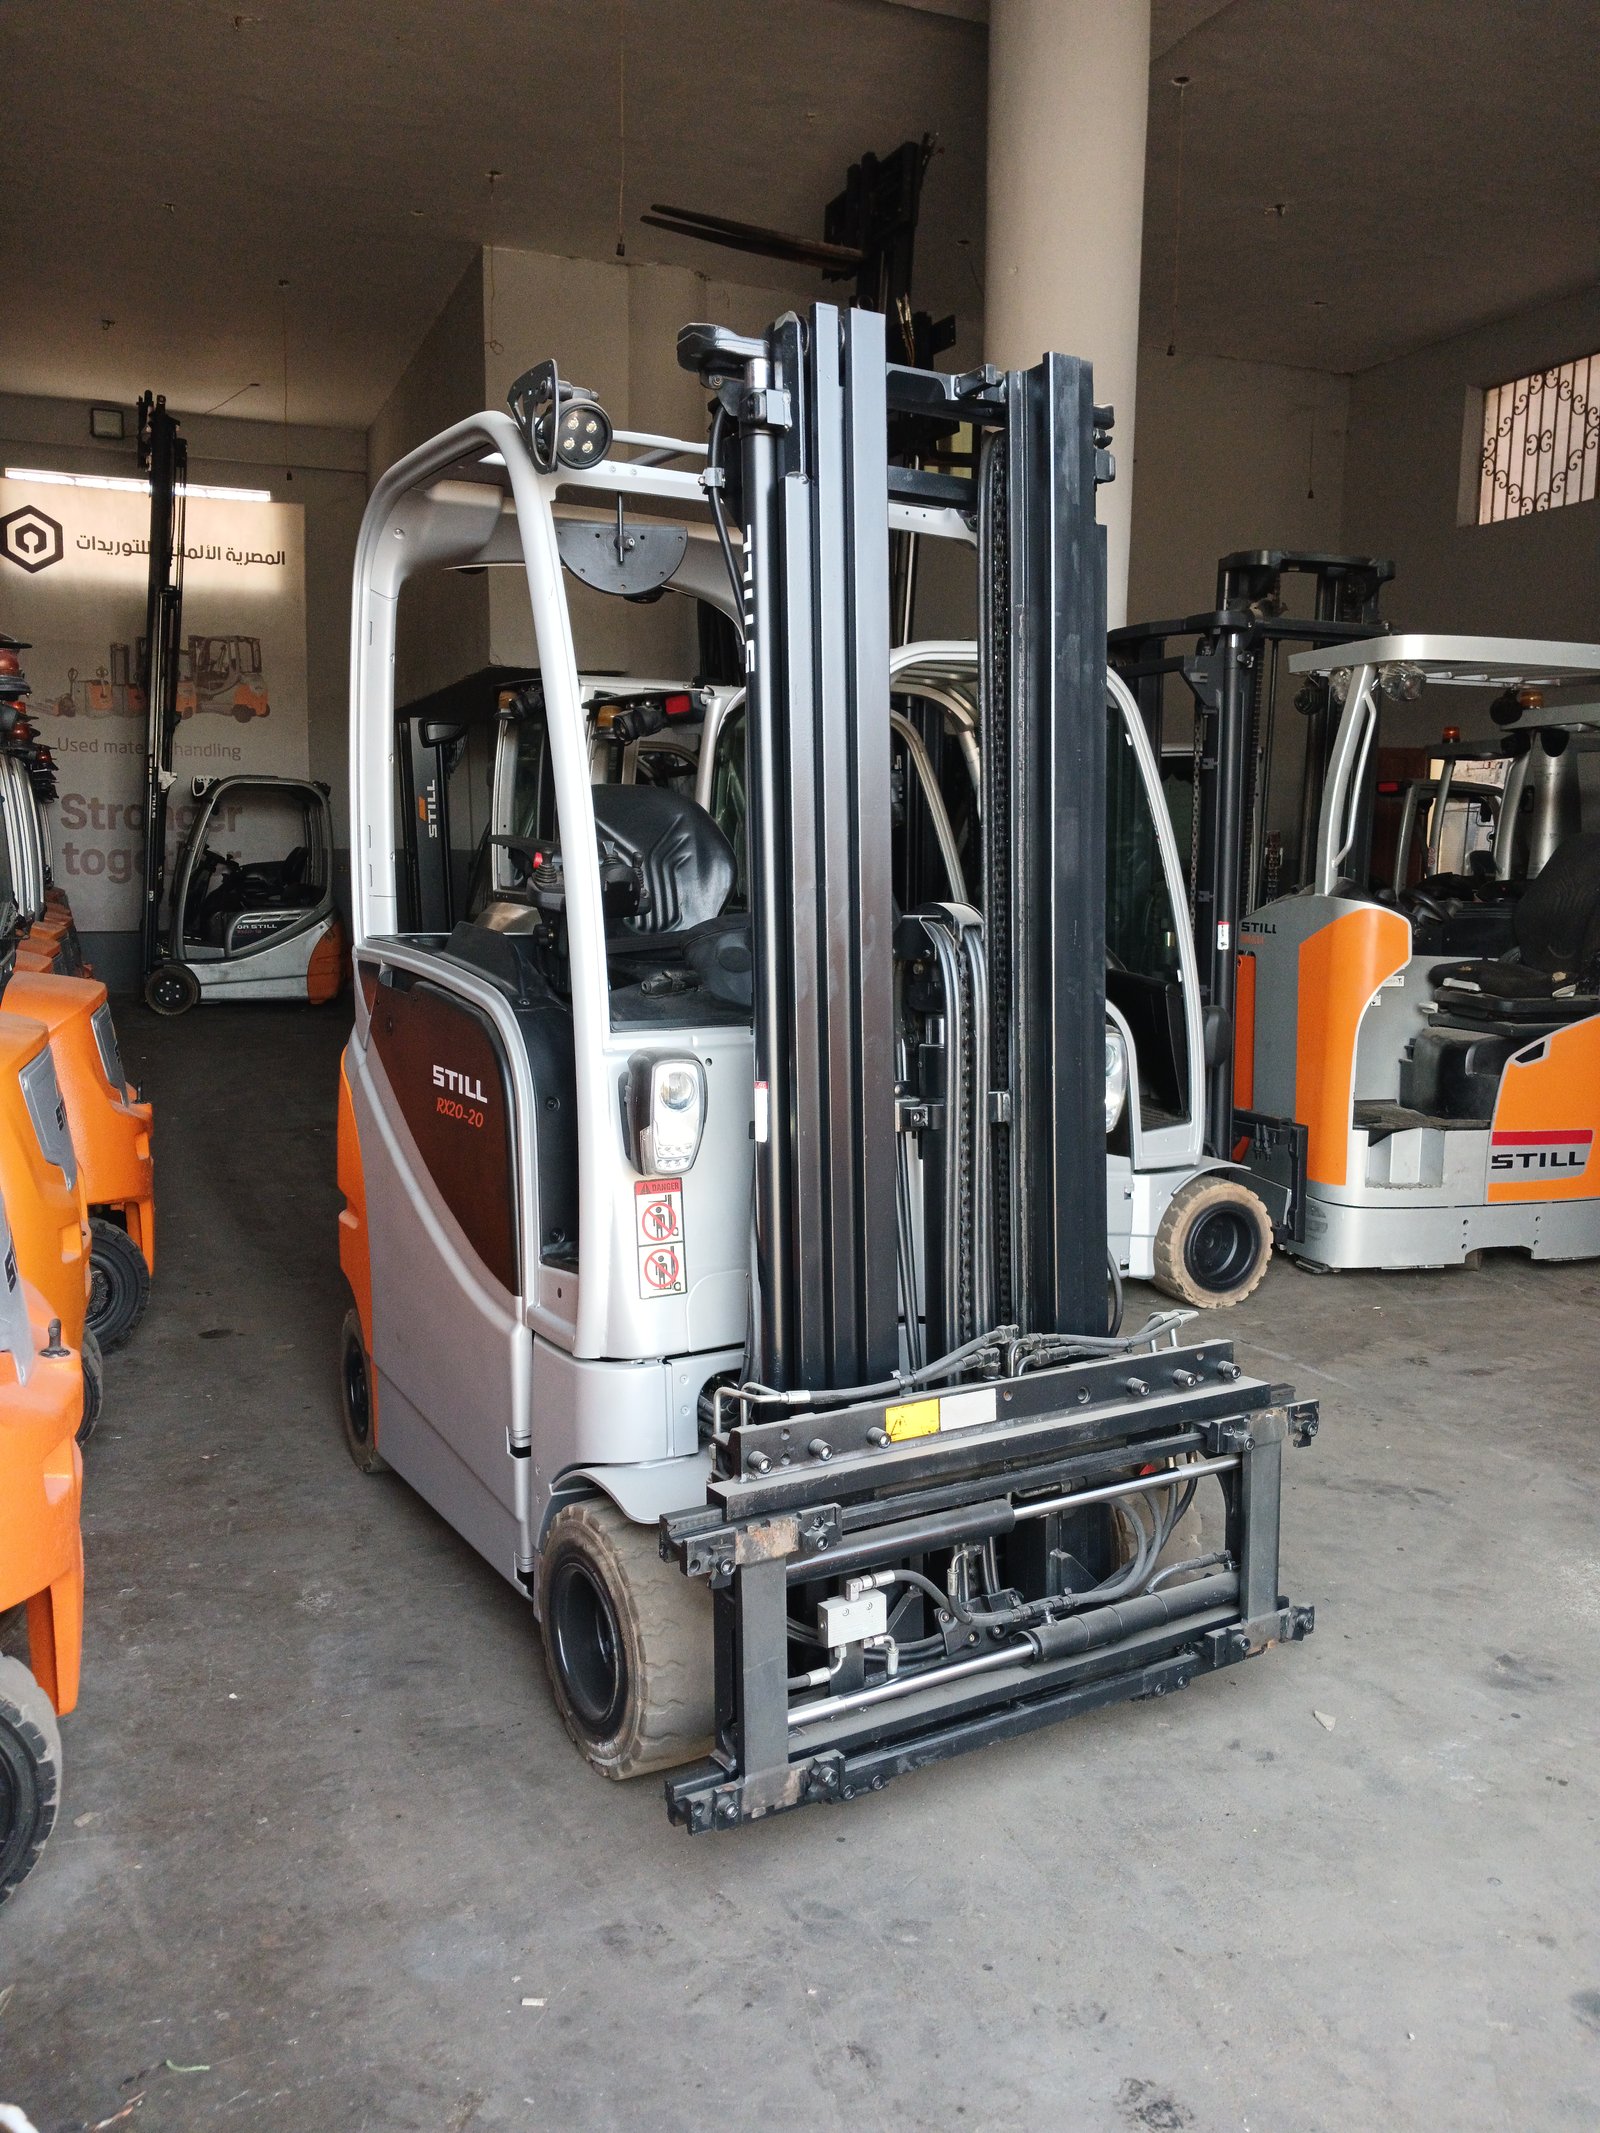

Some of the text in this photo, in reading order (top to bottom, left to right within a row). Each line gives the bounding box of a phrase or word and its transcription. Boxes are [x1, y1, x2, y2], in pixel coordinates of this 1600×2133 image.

[226, 547, 286, 566] المصرية
[57, 737, 99, 753] Used
[174, 742, 241, 761] handling
[427, 779, 437, 838] STILL
[1241, 921, 1277, 935] STILL
[433, 1064, 488, 1104] STILL
[436, 1097, 484, 1128] RX20-20
[1491, 1151, 1585, 1169] STILL
[651, 1182, 680, 1192] DANGER
